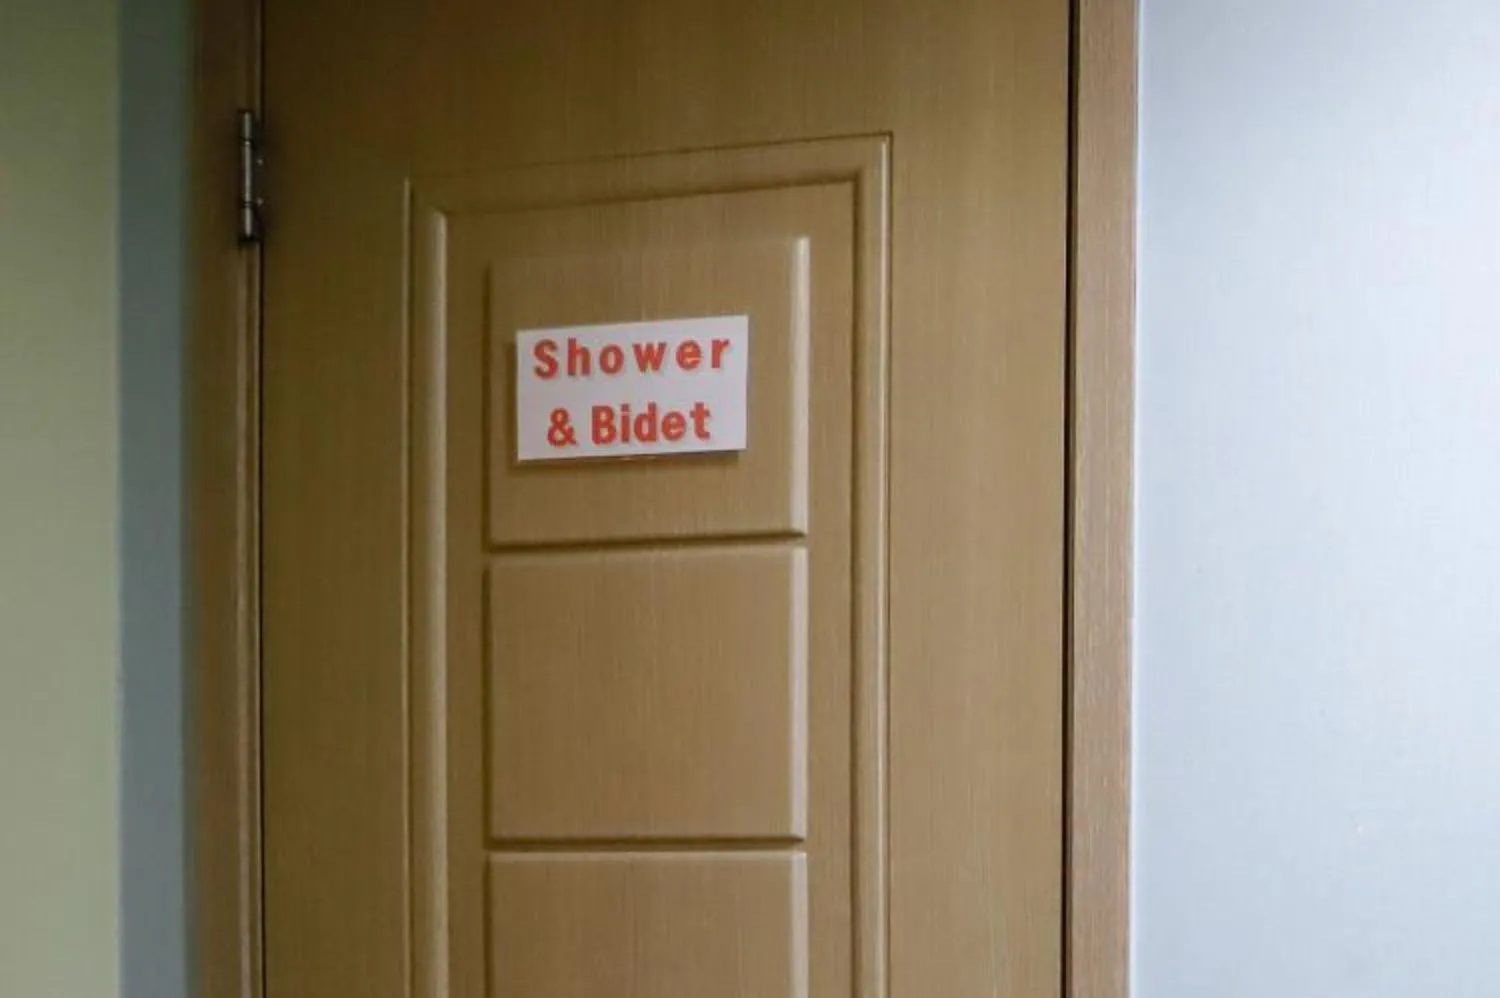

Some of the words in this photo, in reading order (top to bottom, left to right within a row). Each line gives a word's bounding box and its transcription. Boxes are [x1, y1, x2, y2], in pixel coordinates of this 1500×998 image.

[533, 337, 730, 380] Shower
[547, 408, 577, 447] &
[591, 402, 711, 446] Bidet
